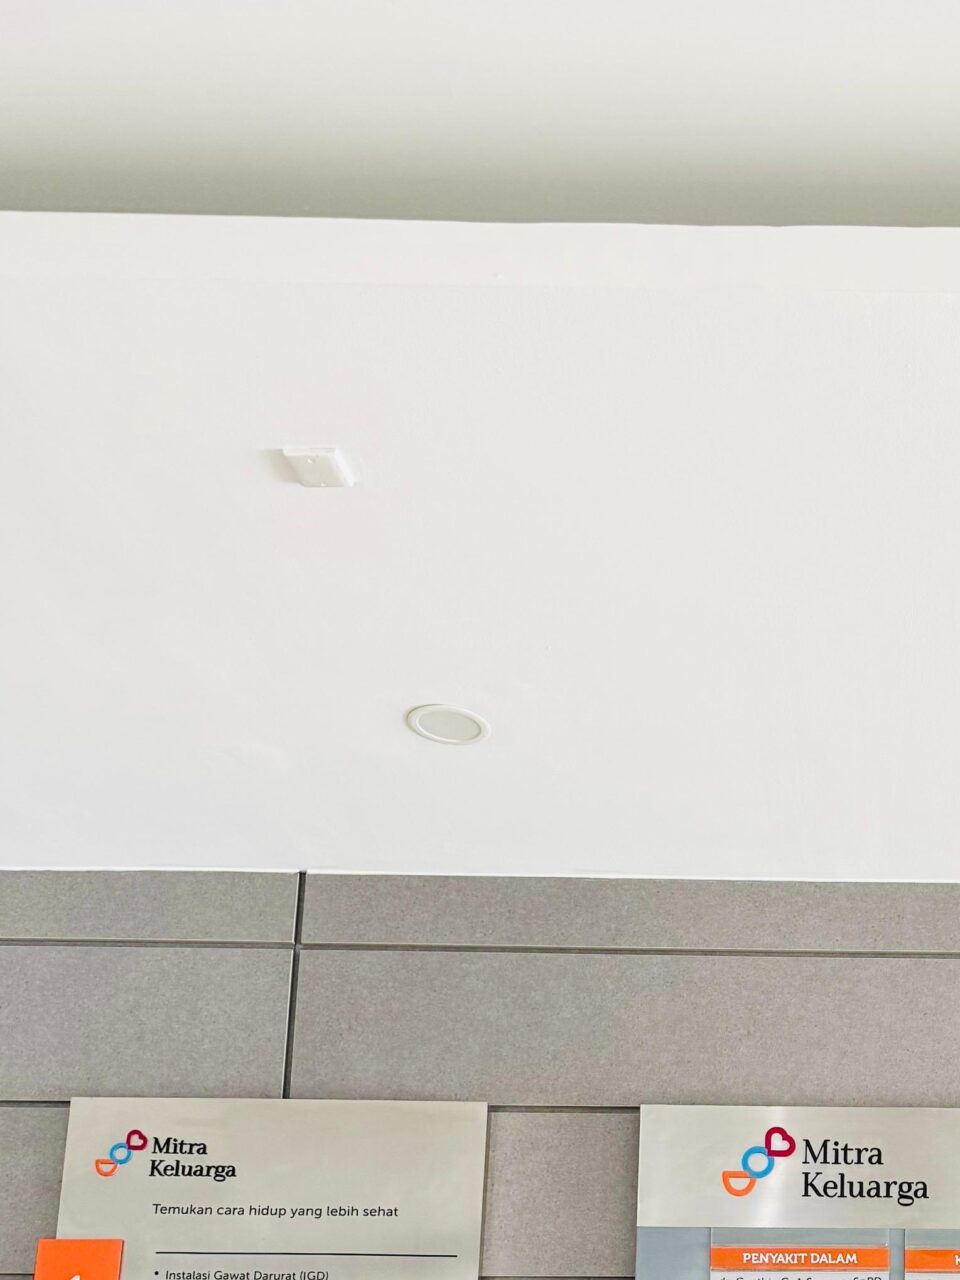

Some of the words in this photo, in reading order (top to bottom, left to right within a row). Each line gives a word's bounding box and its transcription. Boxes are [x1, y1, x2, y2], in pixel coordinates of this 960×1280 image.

[151, 1136, 209, 1155] Mitra
[801, 1138, 885, 1166] Mitra
[148, 1159, 237, 1183] Keluarga
[801, 1171, 930, 1207] Keluarga
[151, 1203, 213, 1216] Temukan
[216, 1206, 245, 1216] cara
[248, 1204, 287, 1219] hidup
[289, 1207, 323, 1220] yang
[326, 1205, 359, 1217] lebih
[362, 1205, 399, 1217] sehat
[742, 1252, 808, 1265] PENYAKIT
[809, 1252, 858, 1264] DALAM
[165, 1269, 211, 1280] Instalasi
[213, 1270, 251, 1280] Gawat
[253, 1270, 297, 1280] Darurat
